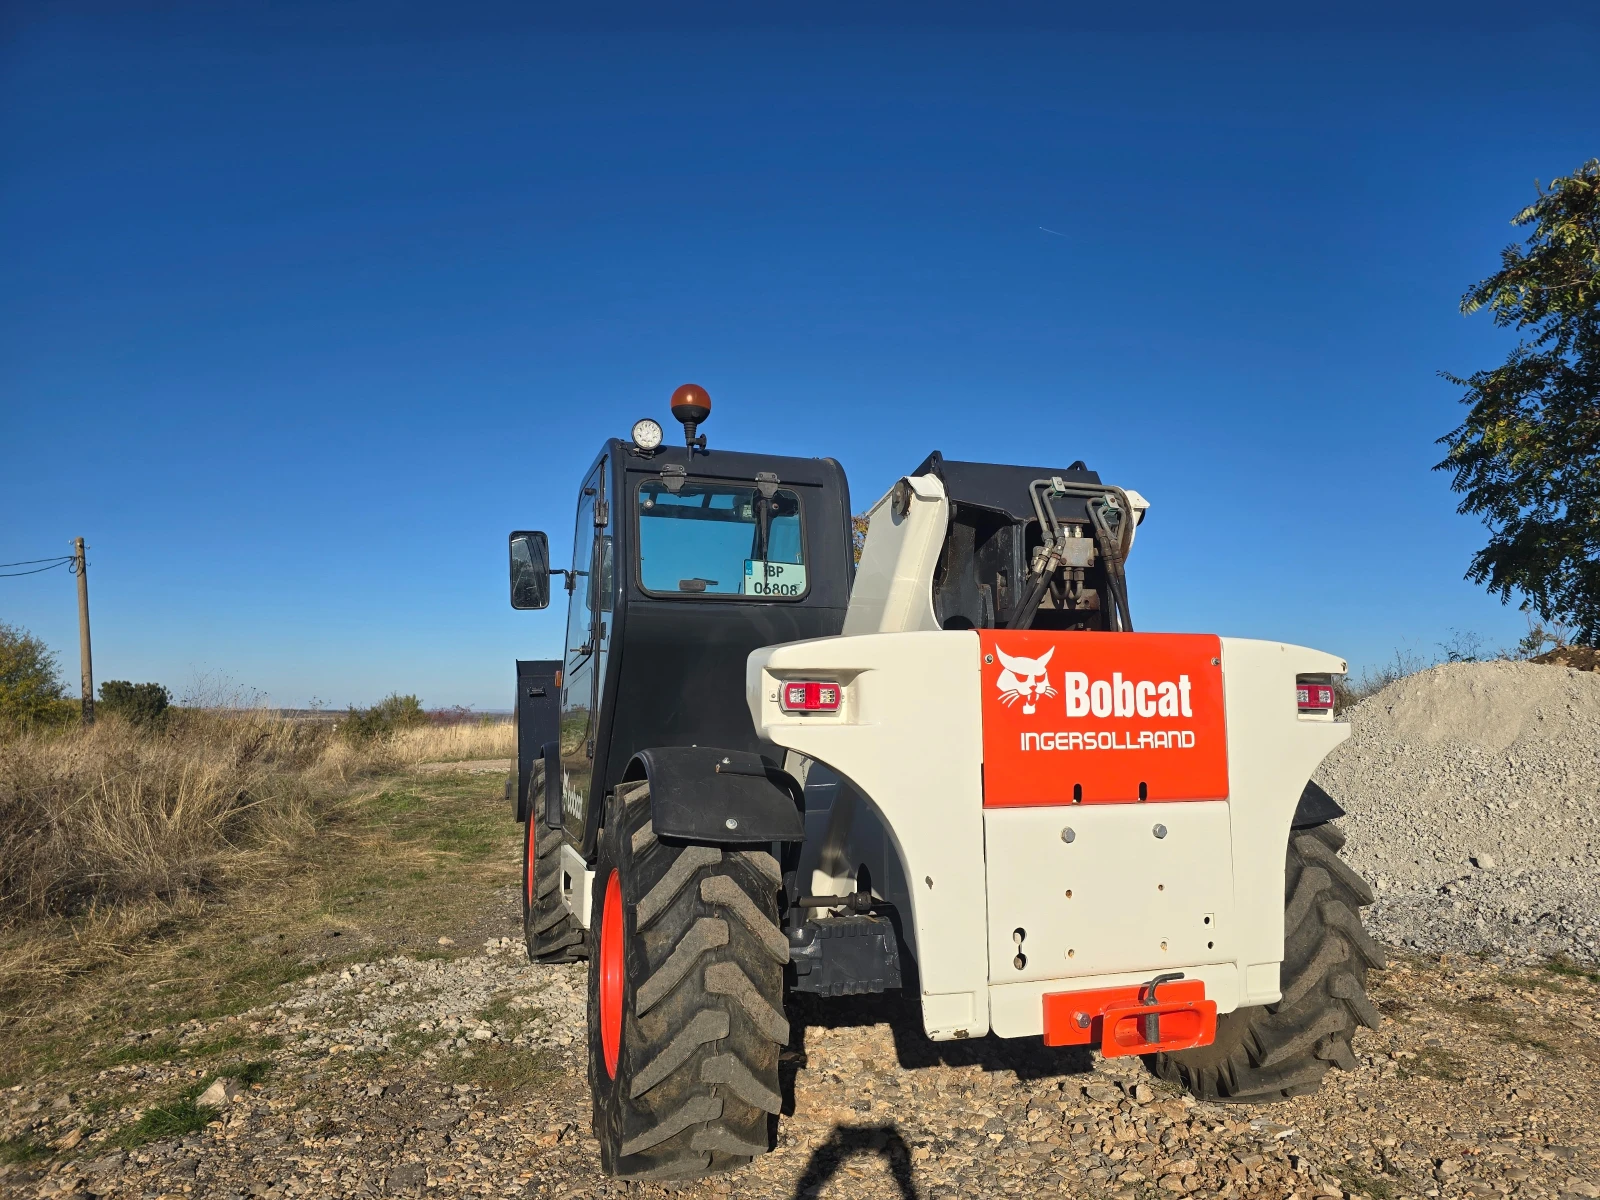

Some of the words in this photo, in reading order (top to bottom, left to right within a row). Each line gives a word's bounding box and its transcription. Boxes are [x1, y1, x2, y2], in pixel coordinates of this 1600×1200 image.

[768, 565, 784, 578] BP
[754, 582, 798, 596] 06808
[1064, 671, 1192, 718] Bobcat
